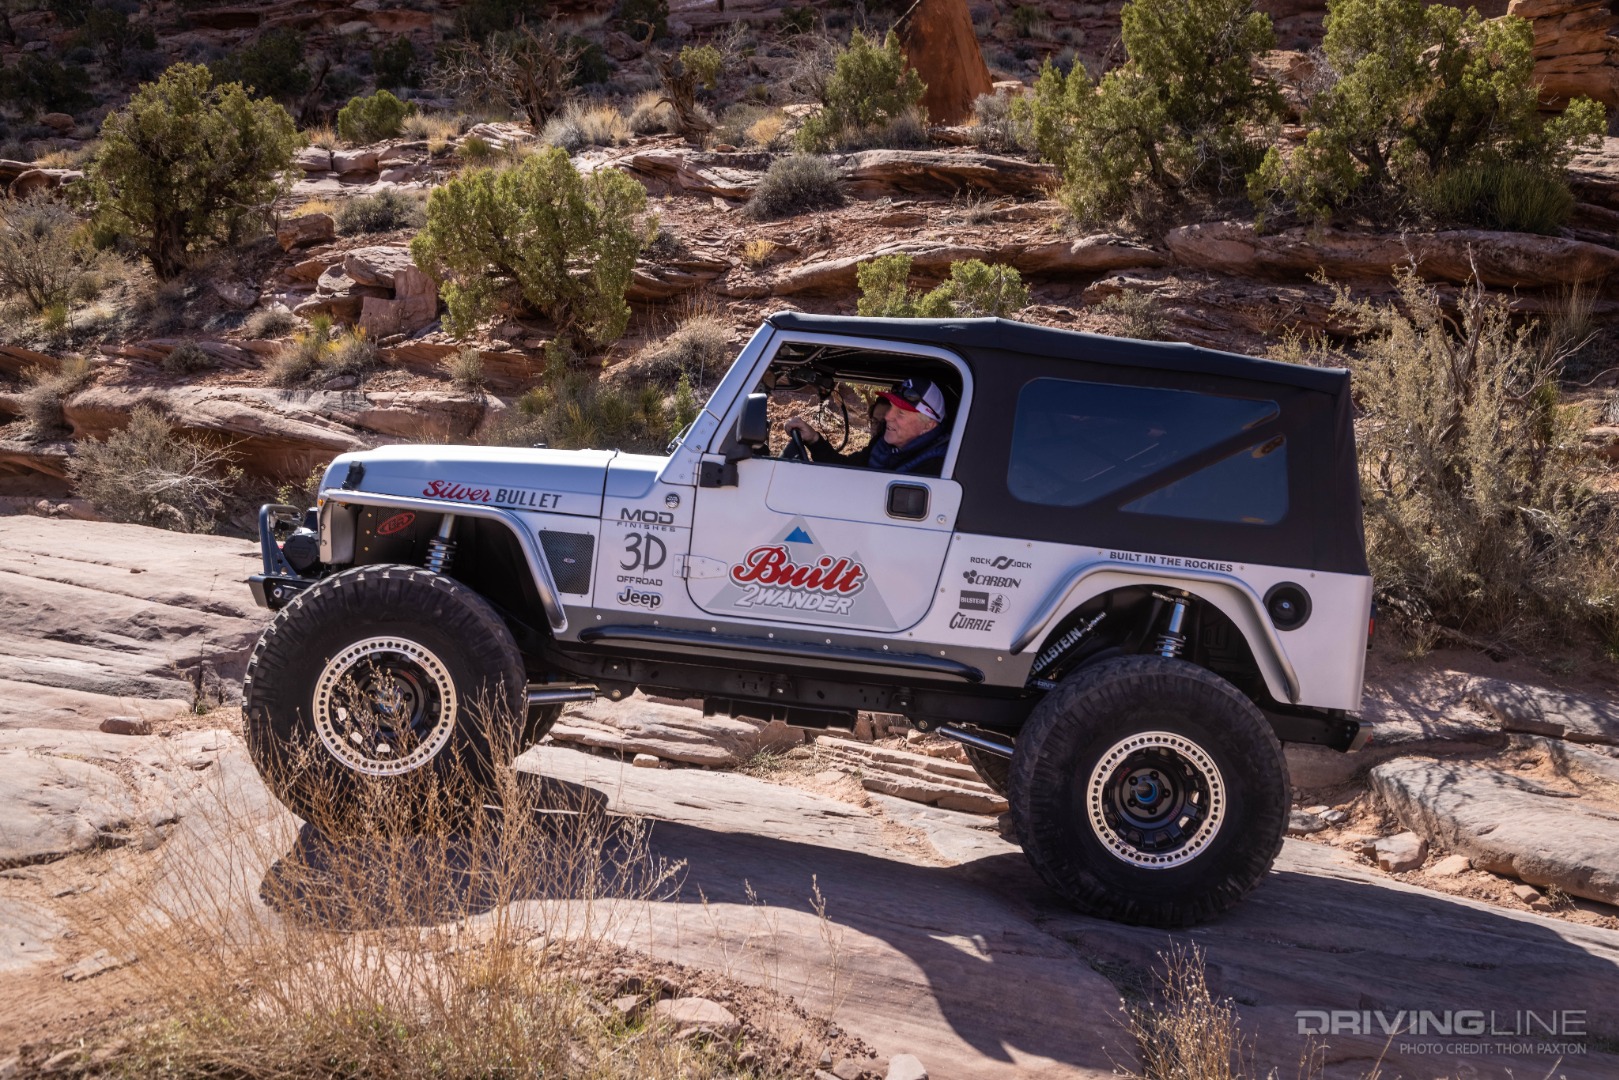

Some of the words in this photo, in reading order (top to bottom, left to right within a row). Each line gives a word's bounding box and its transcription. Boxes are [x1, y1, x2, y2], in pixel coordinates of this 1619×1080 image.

[423, 480, 491, 502] Silver
[495, 488, 563, 509] BULLET
[621, 507, 674, 525] MOD
[616, 521, 676, 532] FINISHES
[620, 531, 667, 574] 3D
[970, 556, 992, 565] ROCK
[1011, 561, 1033, 569] JOCK
[1109, 551, 1141, 562] BUILT
[1145, 555, 1157, 564] IN
[1160, 556, 1182, 567] THE
[1184, 559, 1234, 573] ROCKIES
[732, 546, 864, 593] Built
[616, 575, 663, 587] OFFROAD
[975, 574, 1022, 589] CARBON
[618, 588, 661, 608] Jeep
[734, 584, 854, 616] 2WANDER
[960, 596, 986, 605] BILSTEIN
[949, 611, 996, 632] CURRIE
[1032, 626, 1083, 673] BILSTEIN
